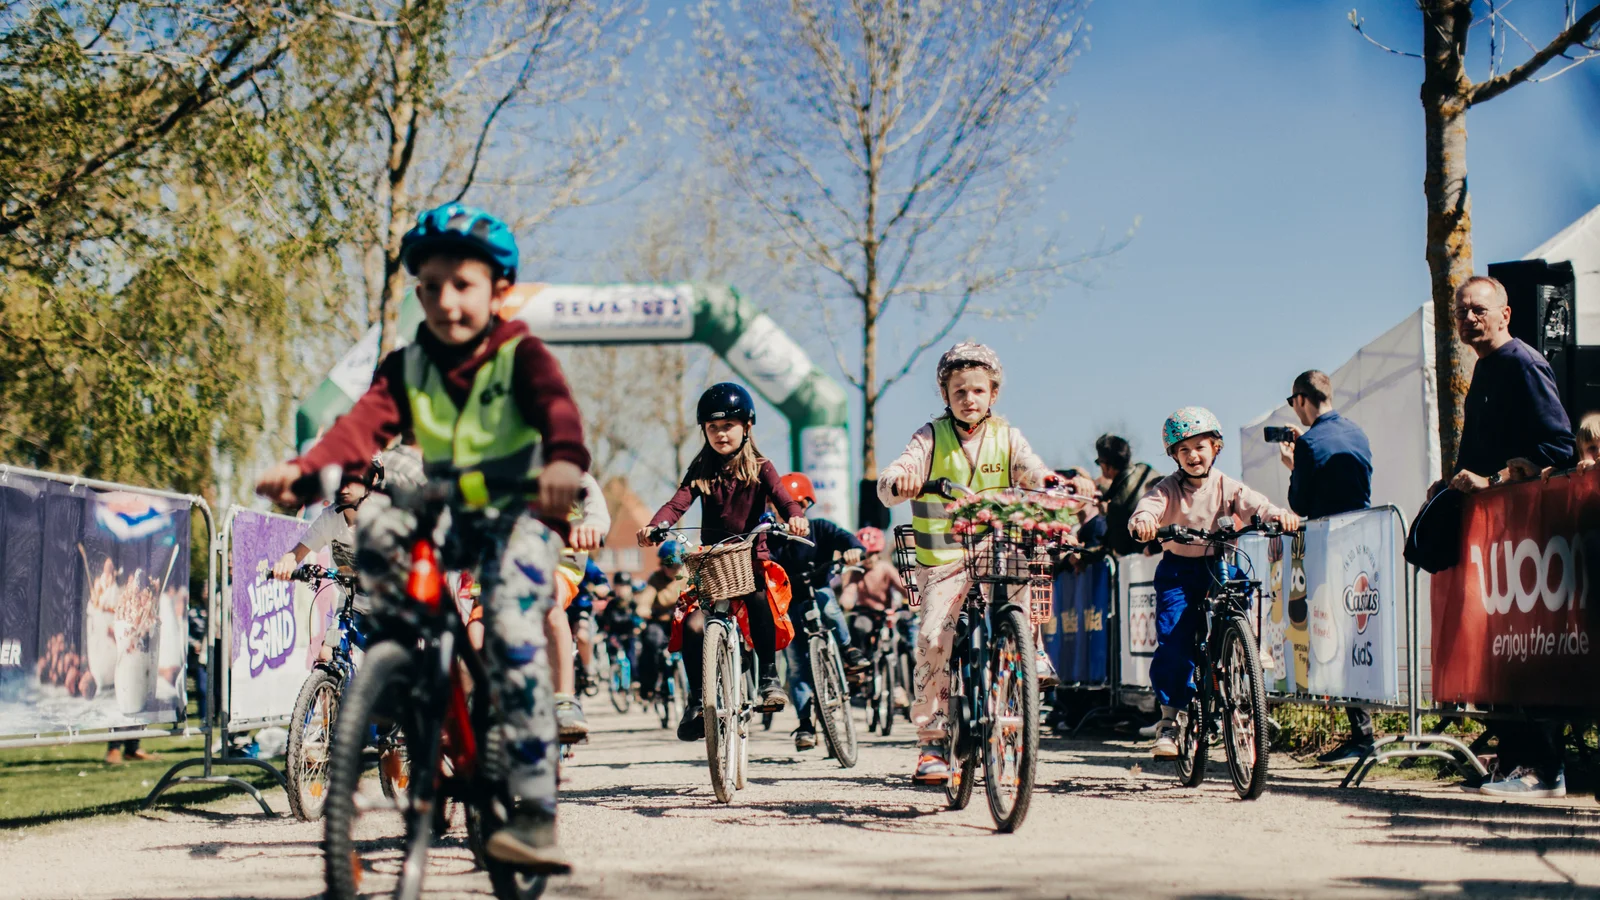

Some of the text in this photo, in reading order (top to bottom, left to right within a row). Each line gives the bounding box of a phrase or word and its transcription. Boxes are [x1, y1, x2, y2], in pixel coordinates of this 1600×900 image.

[1492, 623, 1589, 662] enjoy the ride
